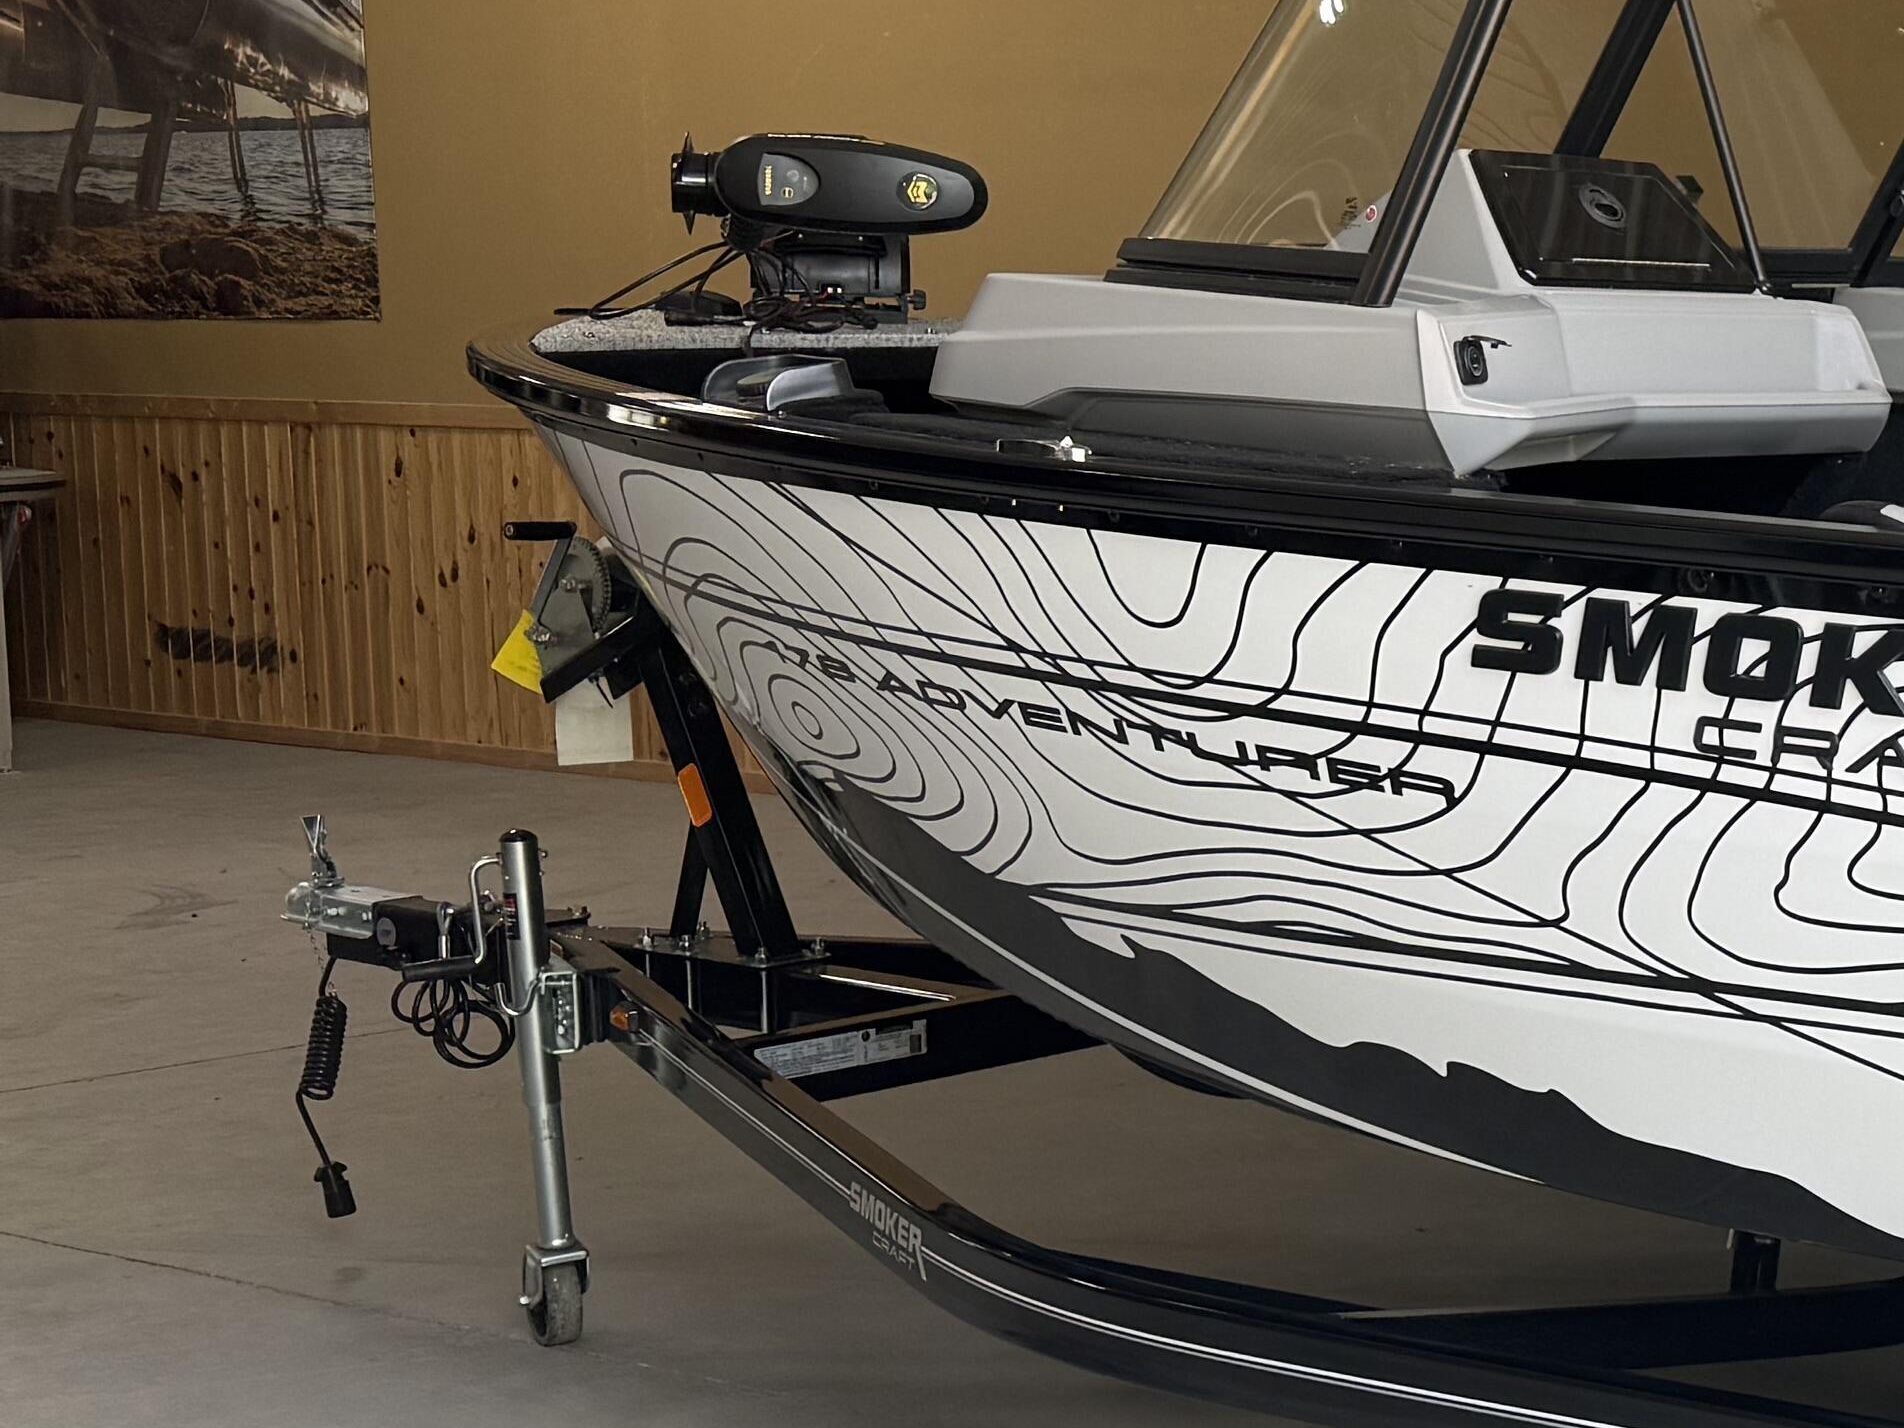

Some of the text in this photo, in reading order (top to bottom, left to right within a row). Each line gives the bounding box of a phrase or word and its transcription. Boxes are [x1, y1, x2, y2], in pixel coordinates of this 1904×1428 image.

[876, 670, 1458, 807] ADVENTURER
[850, 1180, 927, 1282] SMOKER
[872, 1230, 915, 1271] CRAFT
